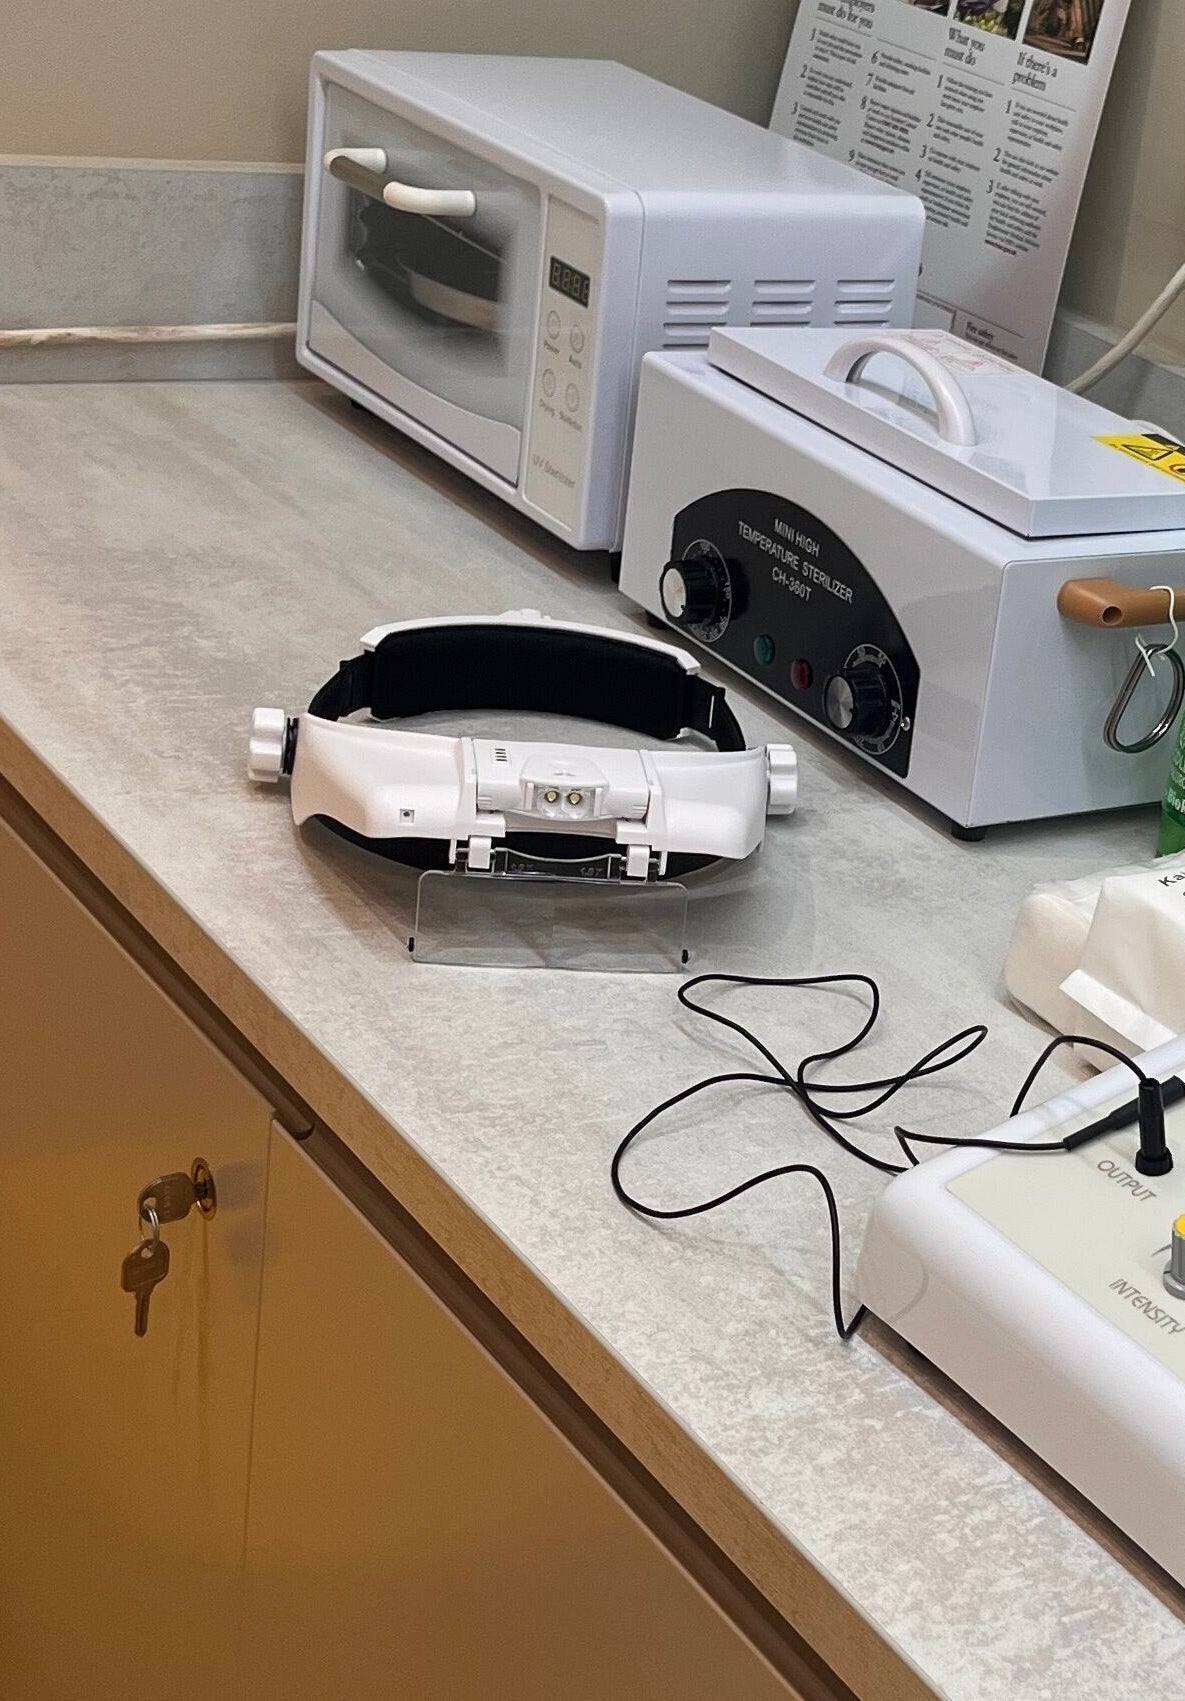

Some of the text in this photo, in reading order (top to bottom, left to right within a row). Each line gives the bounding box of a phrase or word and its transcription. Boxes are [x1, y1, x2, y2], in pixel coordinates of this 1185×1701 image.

[738, 520, 853, 605] TEMPERATURE STERILIZER
[774, 518, 820, 557] MINI HIGH
[1097, 1160, 1158, 1203] OUTPUT
[1108, 1277, 1185, 1337] INTENSITY
